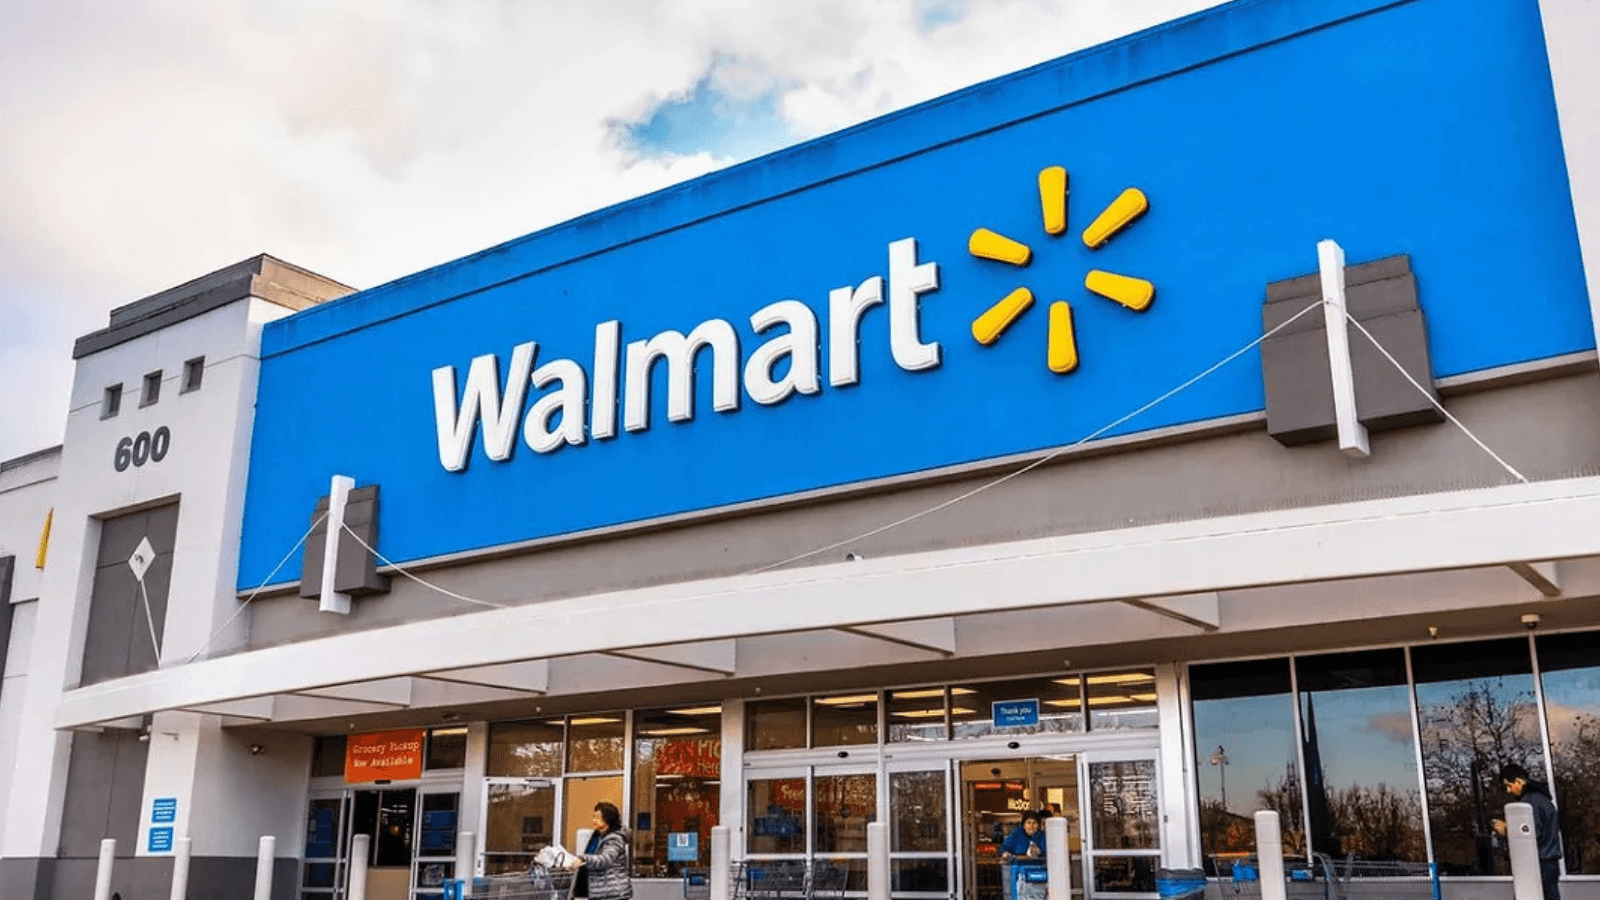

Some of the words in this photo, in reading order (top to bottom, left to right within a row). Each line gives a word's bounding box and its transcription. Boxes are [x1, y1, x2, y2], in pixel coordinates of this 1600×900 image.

[432, 237, 940, 472] Walmart
[115, 425, 170, 472] 600
[353, 744, 386, 754] Grocery
[389, 742, 420, 752] Pickup
[370, 756, 413, 767] Available
